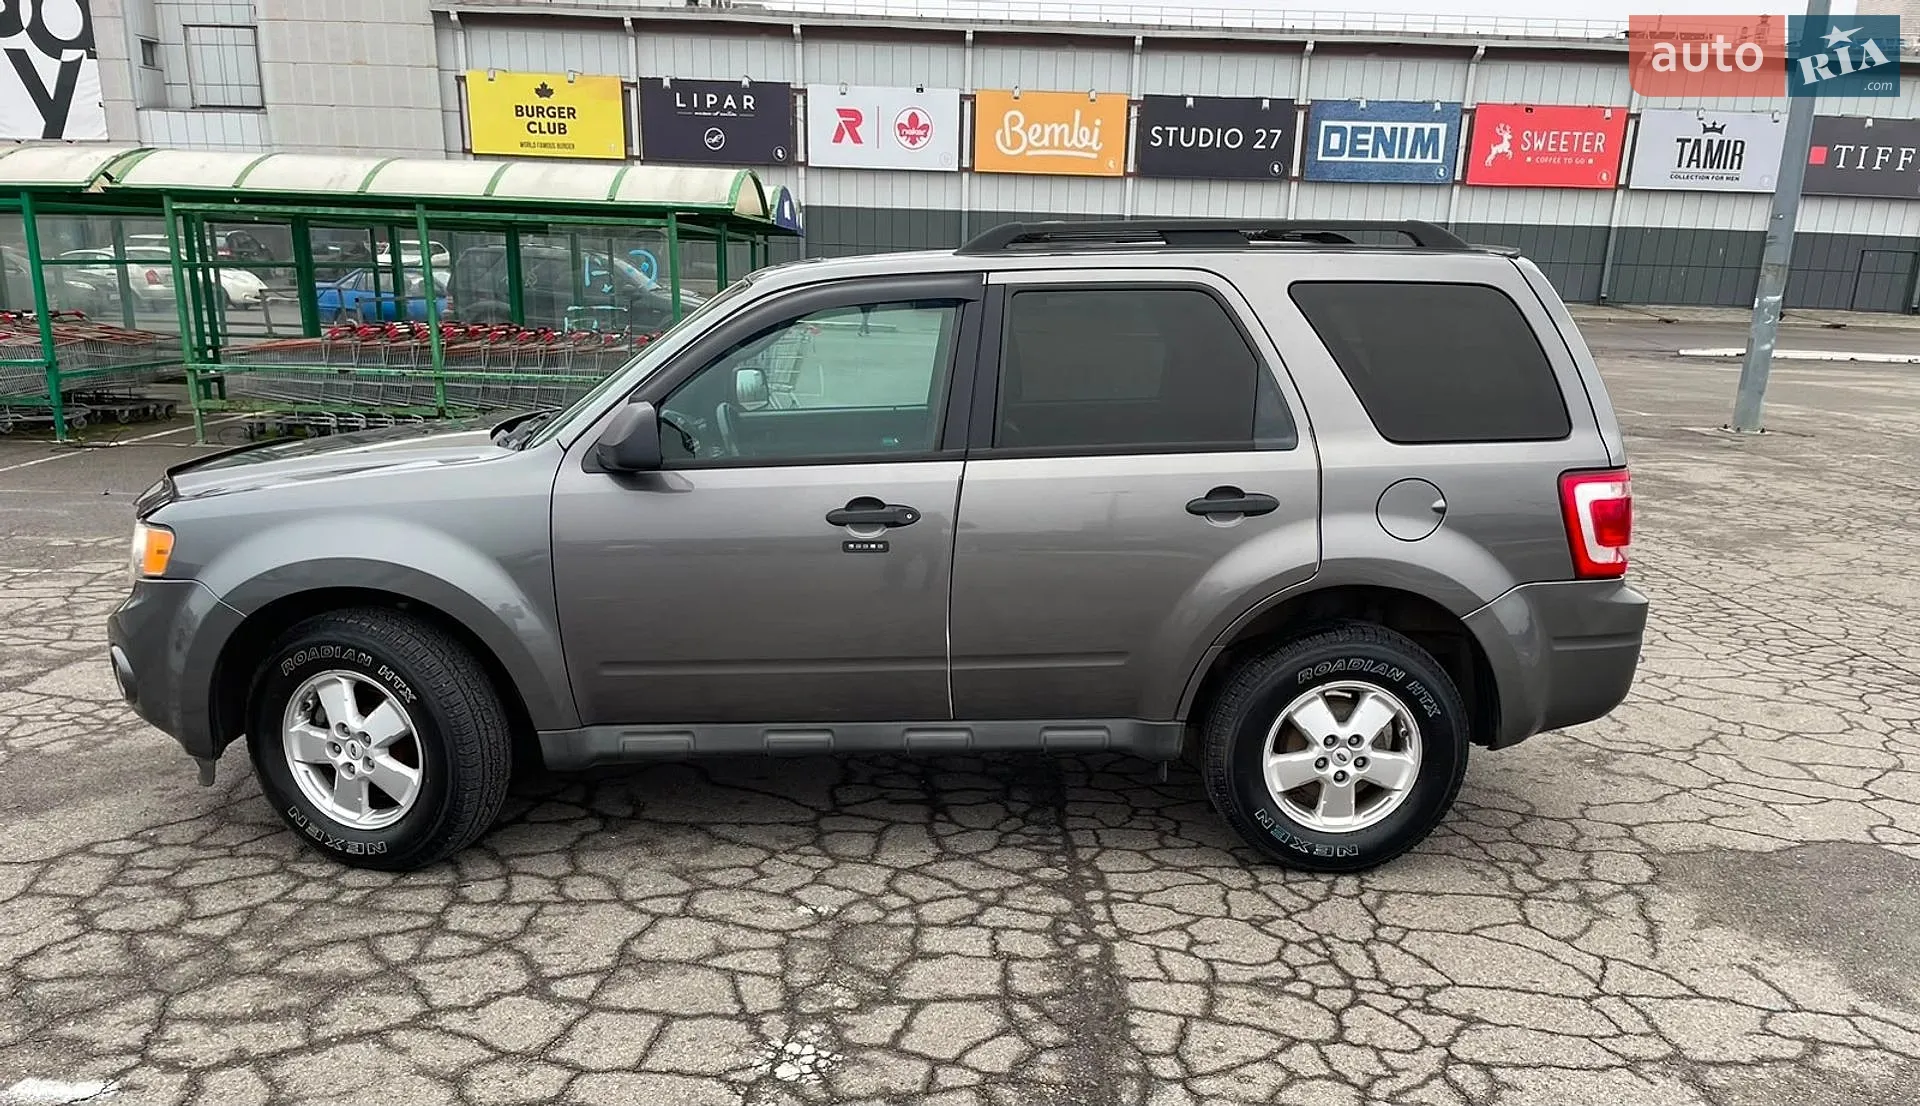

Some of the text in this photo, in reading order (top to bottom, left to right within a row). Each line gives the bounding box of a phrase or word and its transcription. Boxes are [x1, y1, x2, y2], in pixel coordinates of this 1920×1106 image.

[514, 104, 577, 119] BURGER
[675, 92, 755, 110] LIPAR
[526, 121, 568, 135] CLUB
[832, 108, 864, 144] R
[995, 109, 1102, 156] Bembi
[1150, 126, 1283, 150] STUDIO 27
[1321, 124, 1441, 161] DENIM
[1520, 130, 1606, 153] SWEETER
[1676, 138, 1746, 170] TAMIR
[1535, 156, 1586, 165] COFFEE TO GO
[1833, 144, 1920, 171] TIFF
[1670, 173, 1710, 181] COLLECTION
[280, 645, 417, 704] ROADIAN HTX
[1297, 658, 1442, 717] ROADIAN HTX
[288, 806, 387, 855] NEXEN
[1254, 808, 1359, 857] NEXEN
